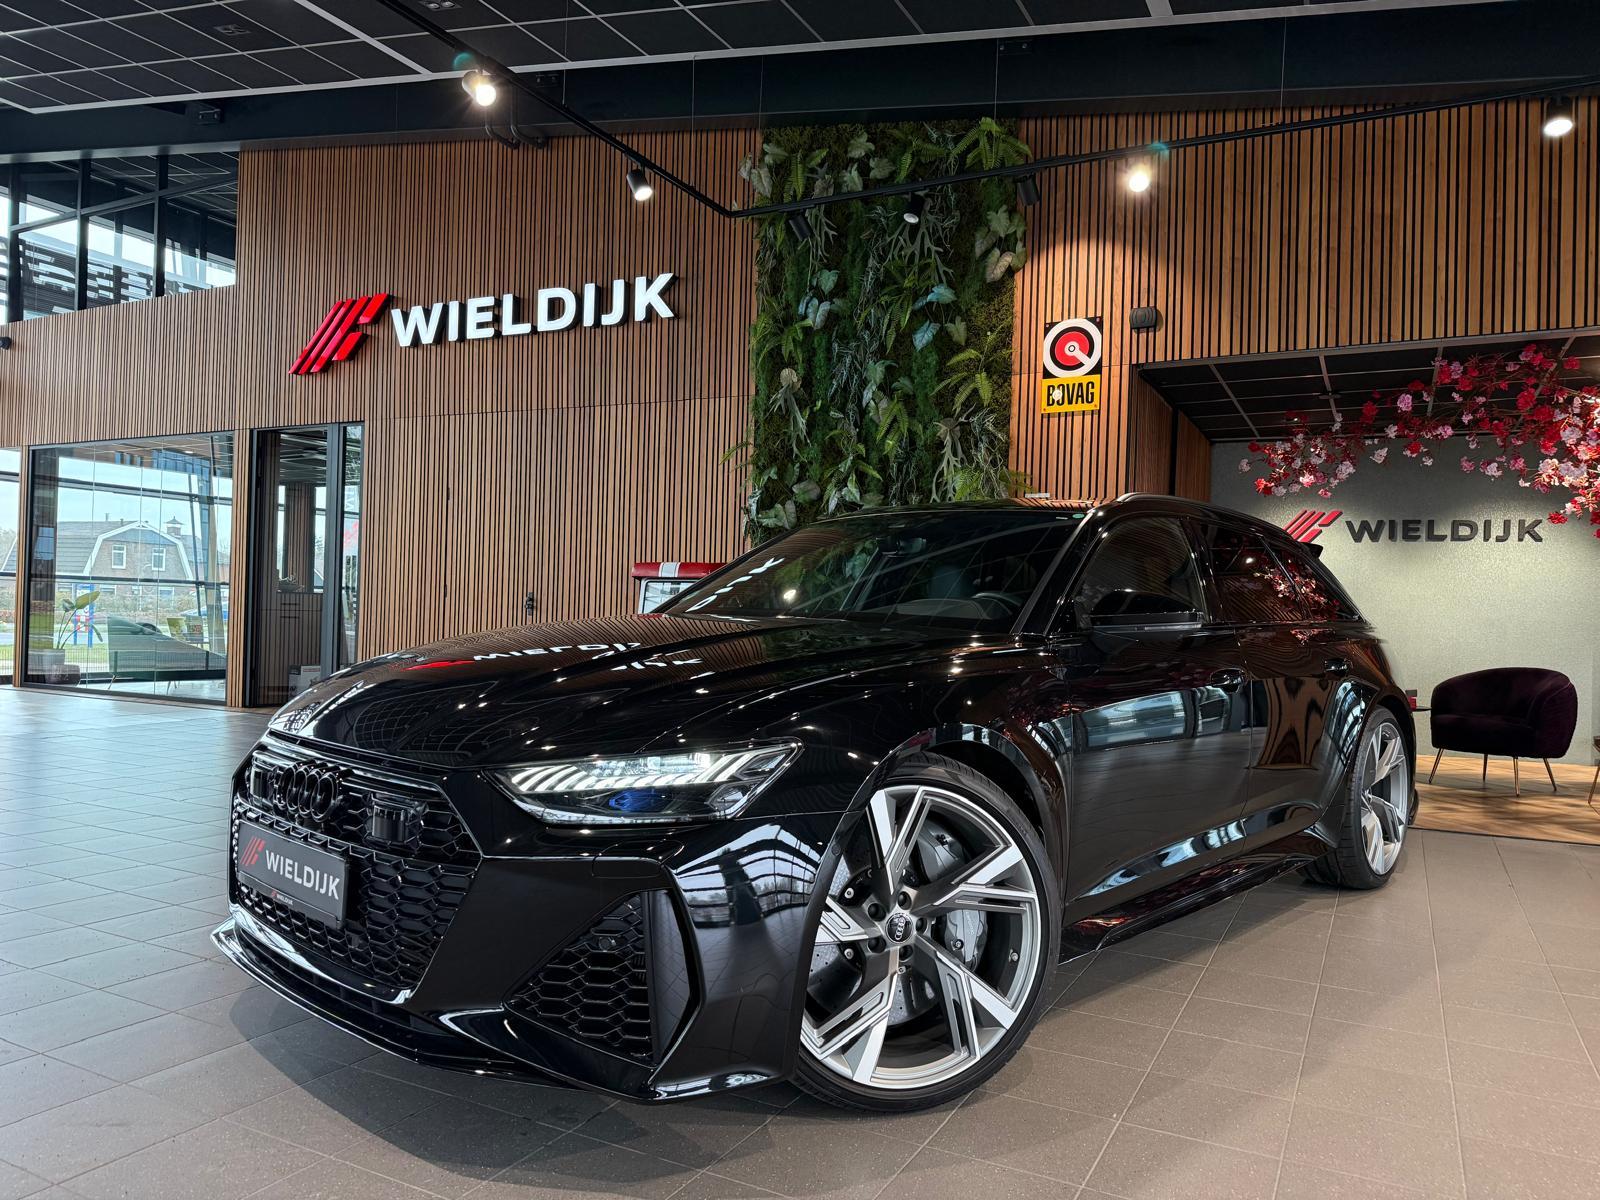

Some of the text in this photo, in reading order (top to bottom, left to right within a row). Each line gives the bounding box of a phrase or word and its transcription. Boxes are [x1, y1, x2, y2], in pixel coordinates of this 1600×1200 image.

[392, 272, 675, 347] WIELDIJK
[1047, 382, 1095, 407] BOVAG
[1345, 519, 1543, 543] WIELDIJK
[265, 849, 340, 900] WIELDIJK
